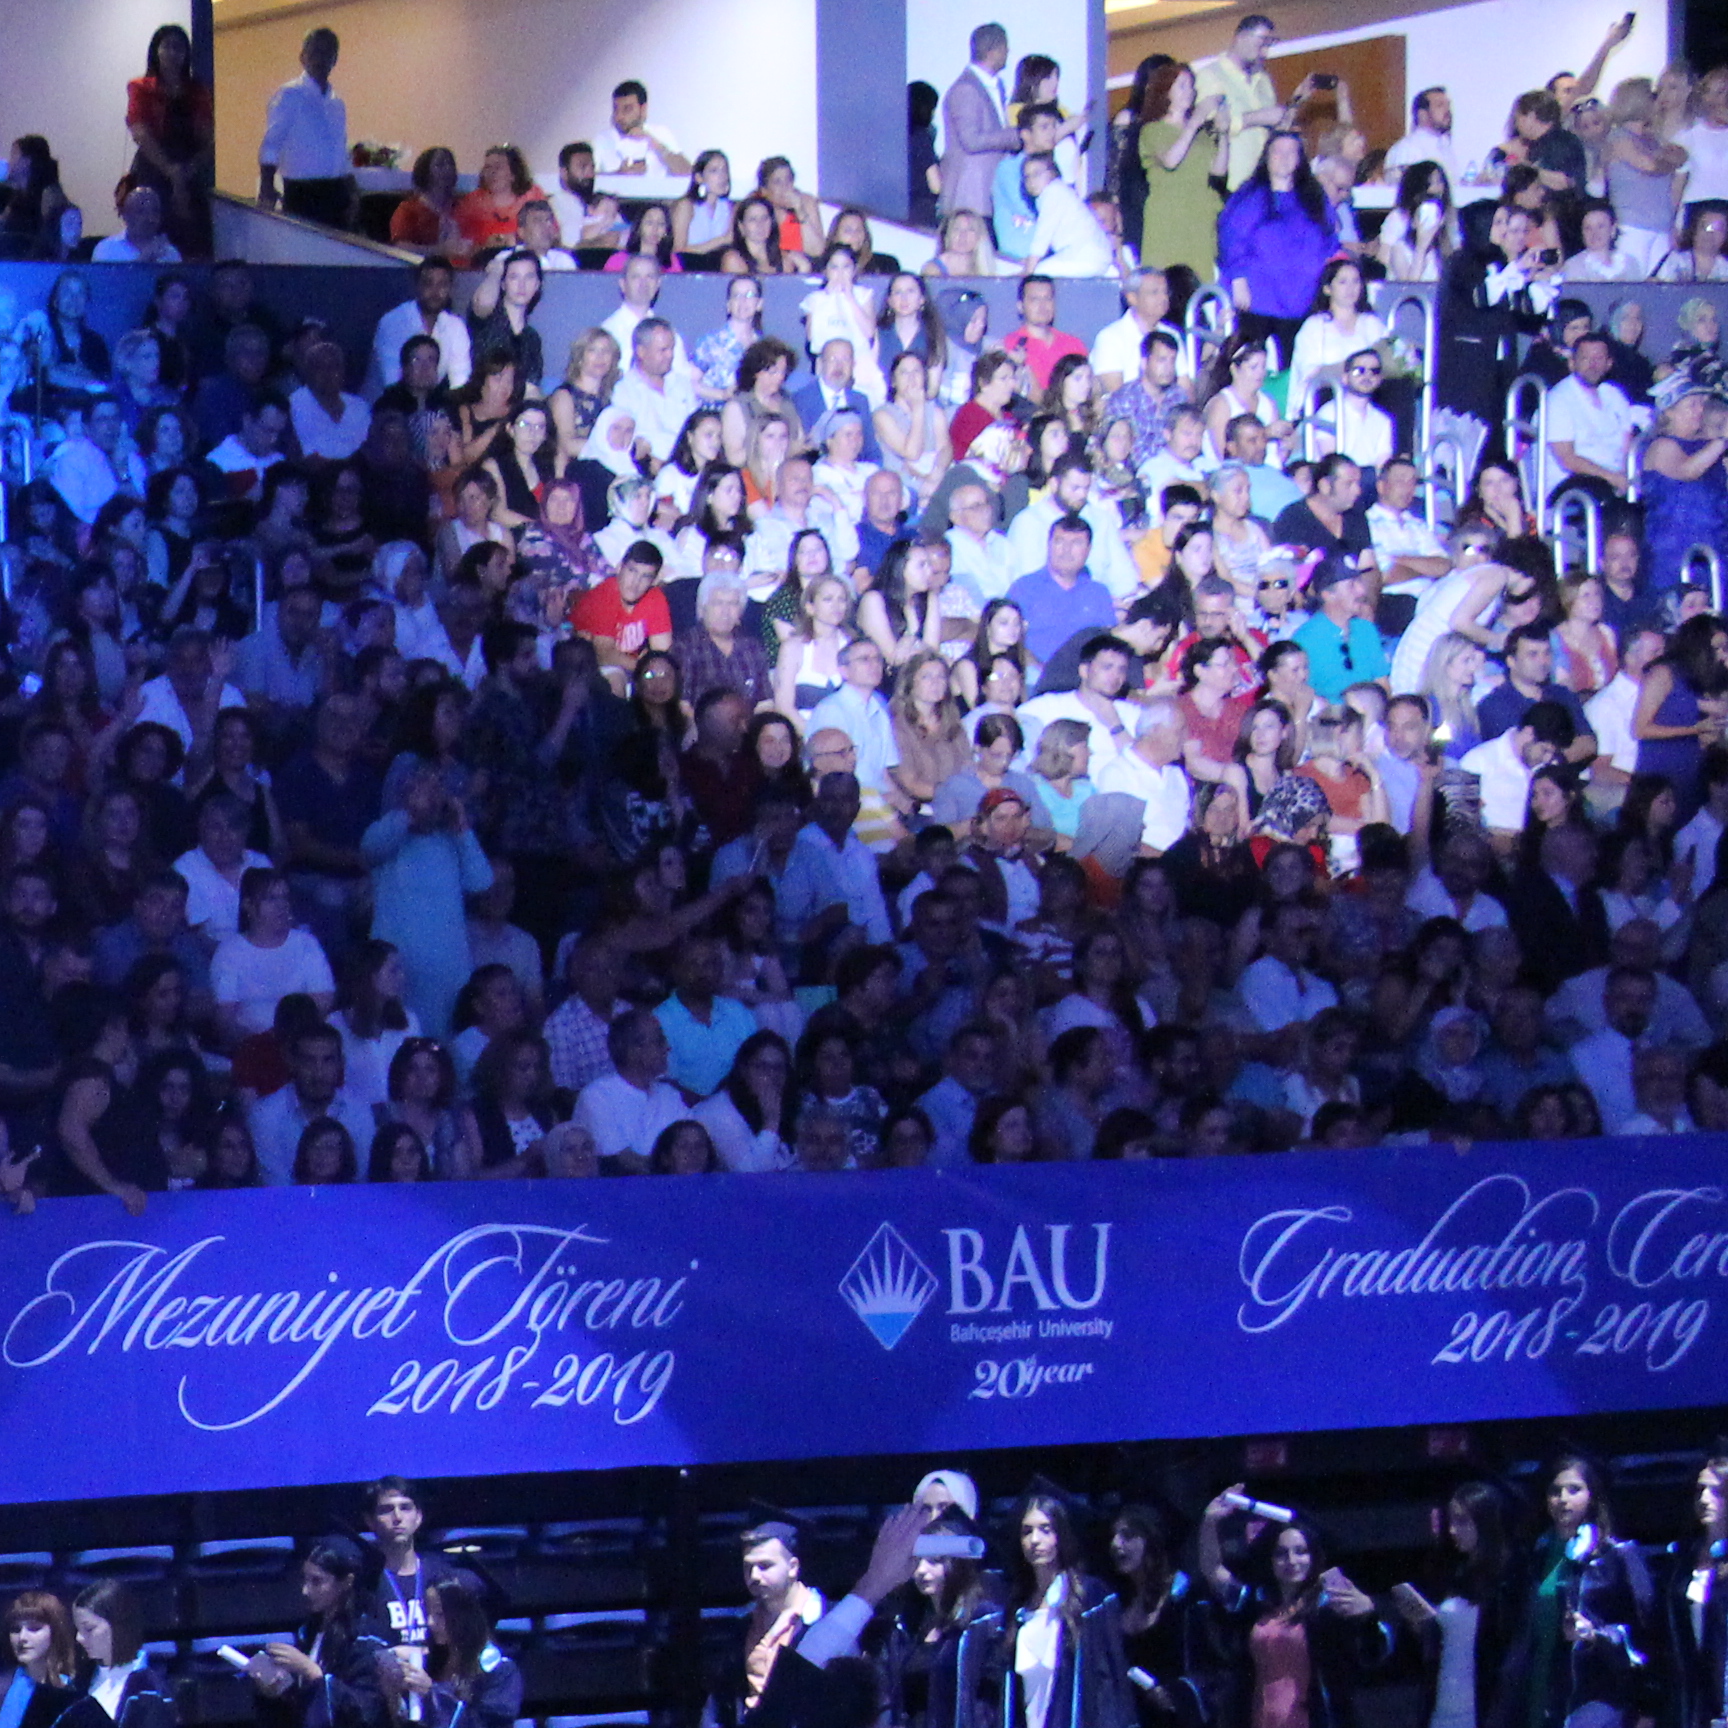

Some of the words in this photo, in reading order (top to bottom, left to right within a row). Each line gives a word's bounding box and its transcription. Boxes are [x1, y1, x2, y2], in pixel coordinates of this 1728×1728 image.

[940, 1223, 1113, 1315] BAU
[1238, 1174, 1599, 1333] Graduation
[2, 1236, 434, 1431] Mezuniyet
[443, 1223, 699, 1347] Töreni
[950, 1320, 1033, 1343] Bahçeşehir
[1038, 1317, 1114, 1340] University
[1430, 1297, 1710, 1373] 2018-2019
[366, 1346, 674, 1426] 2018-2019
